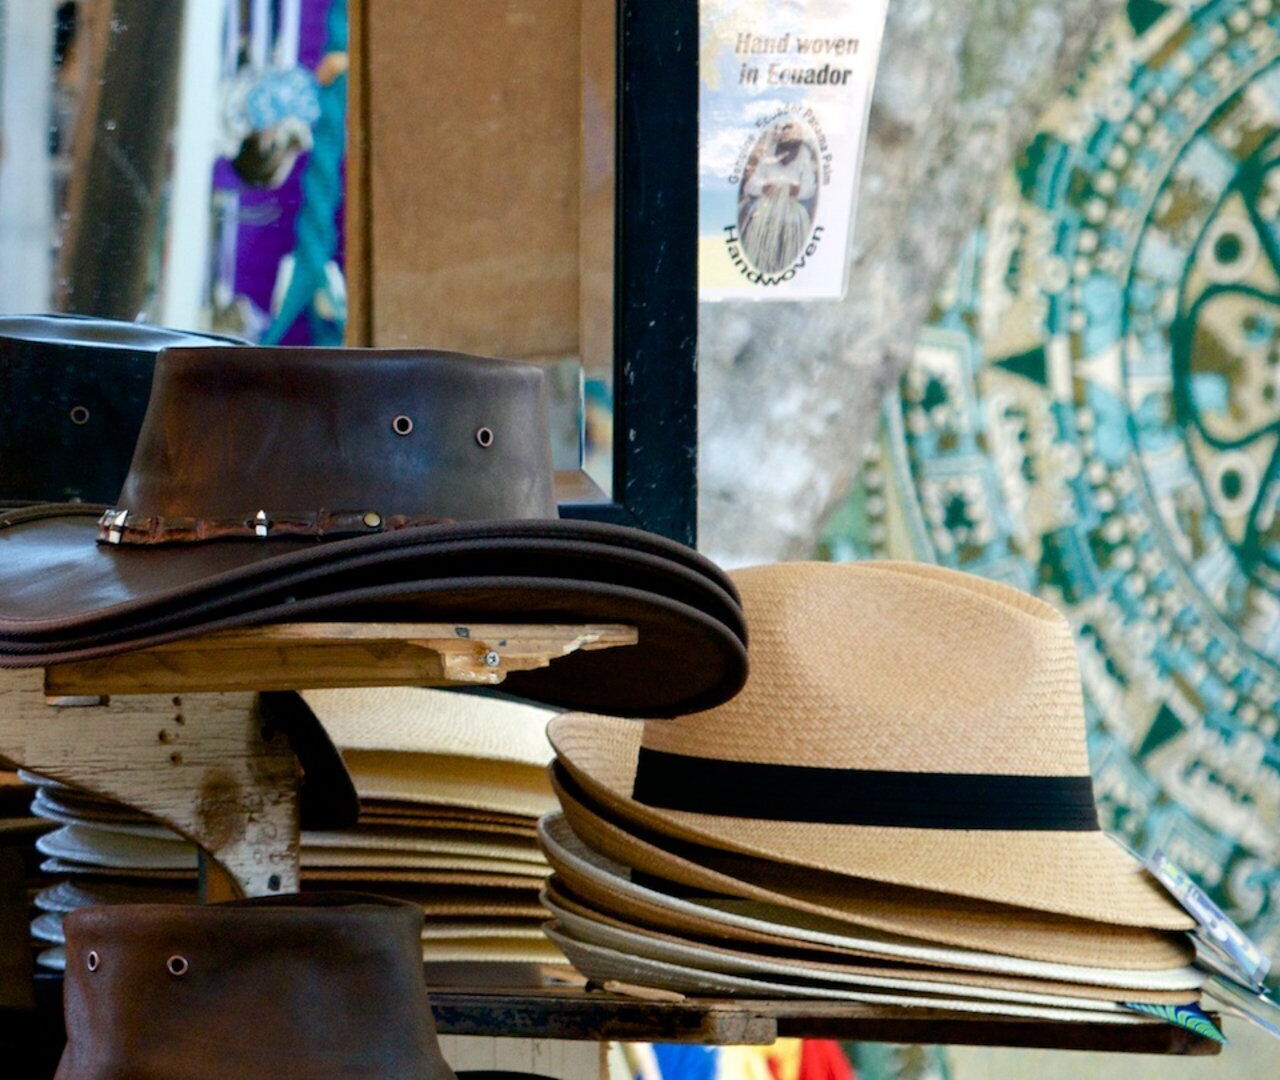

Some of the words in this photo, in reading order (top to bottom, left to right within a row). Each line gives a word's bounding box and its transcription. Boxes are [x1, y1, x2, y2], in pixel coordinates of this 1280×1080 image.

[735, 32, 790, 55] Hand
[796, 37, 859, 56] woven
[738, 62, 759, 86] in
[767, 62, 853, 86] Ecuador
[723, 224, 824, 287] Handwoven
